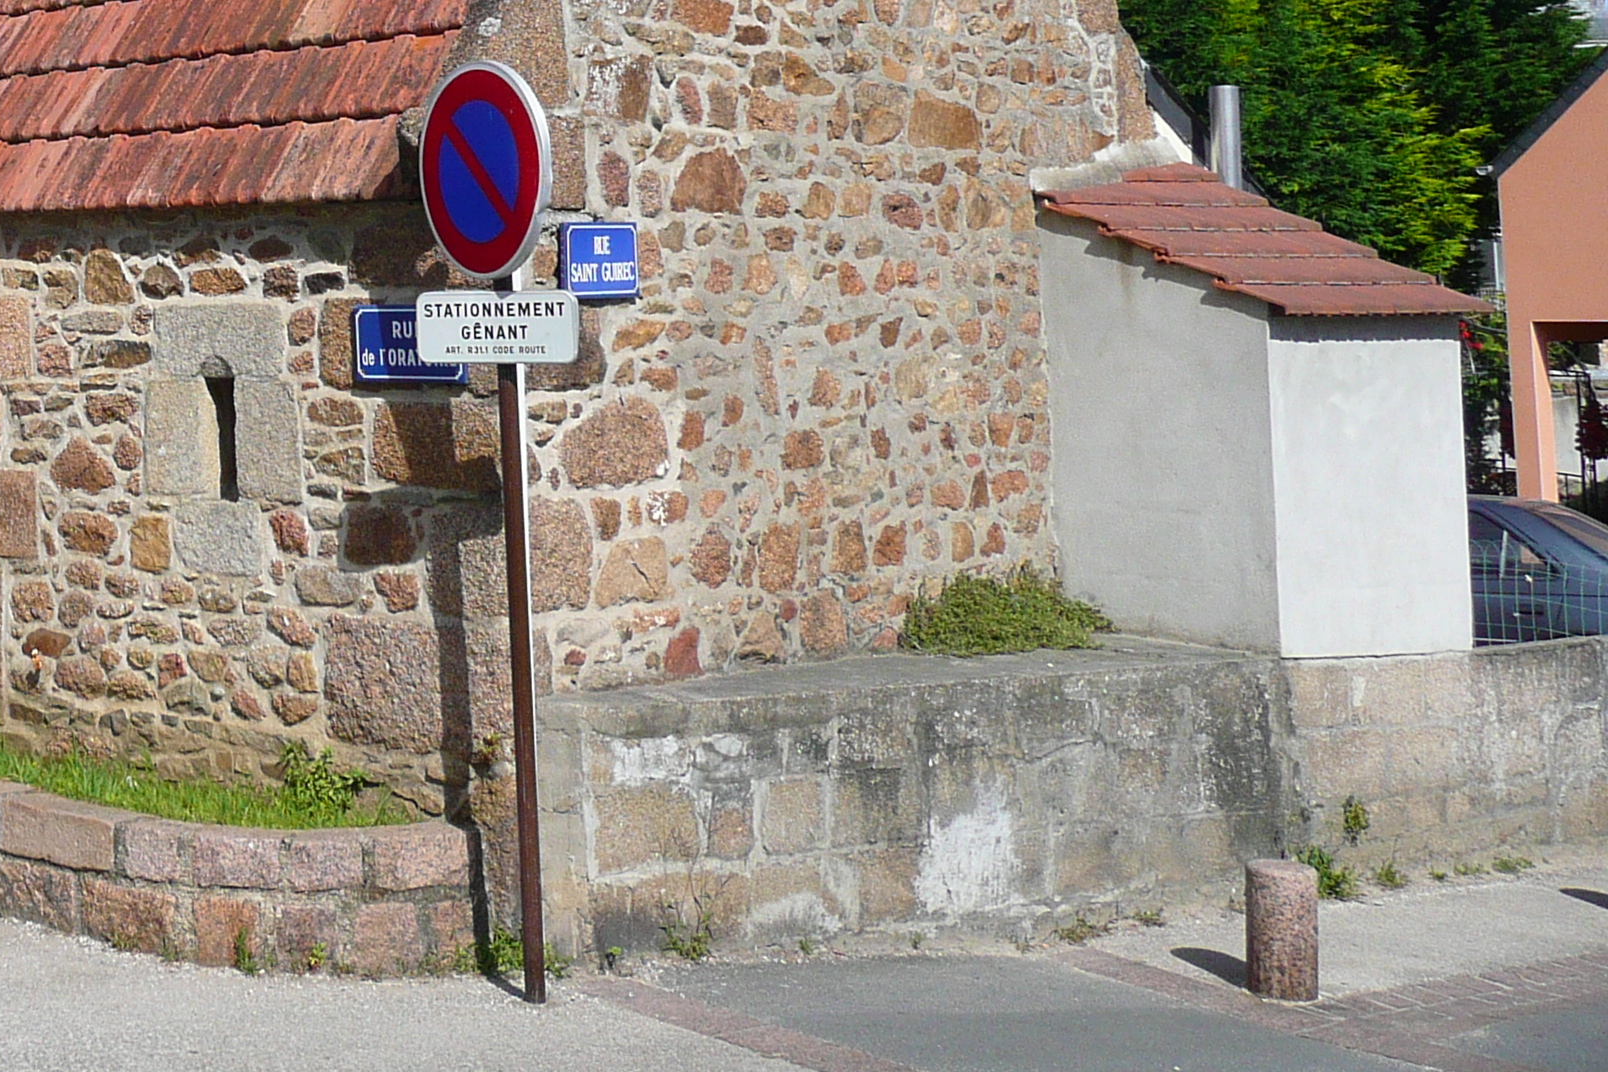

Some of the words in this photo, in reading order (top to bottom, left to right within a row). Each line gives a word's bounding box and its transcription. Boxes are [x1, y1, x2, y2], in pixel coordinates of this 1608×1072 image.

[593, 235, 611, 255] RUE
[571, 262, 598, 282] SAINT
[601, 261, 635, 282] GUIREC
[423, 302, 565, 318] STATIONNEMENT
[461, 322, 528, 340] GÊNANT
[362, 348, 375, 366] de
[445, 346, 463, 354] ART.
[492, 345, 514, 354] CODE
[518, 345, 546, 354] ROUTE
